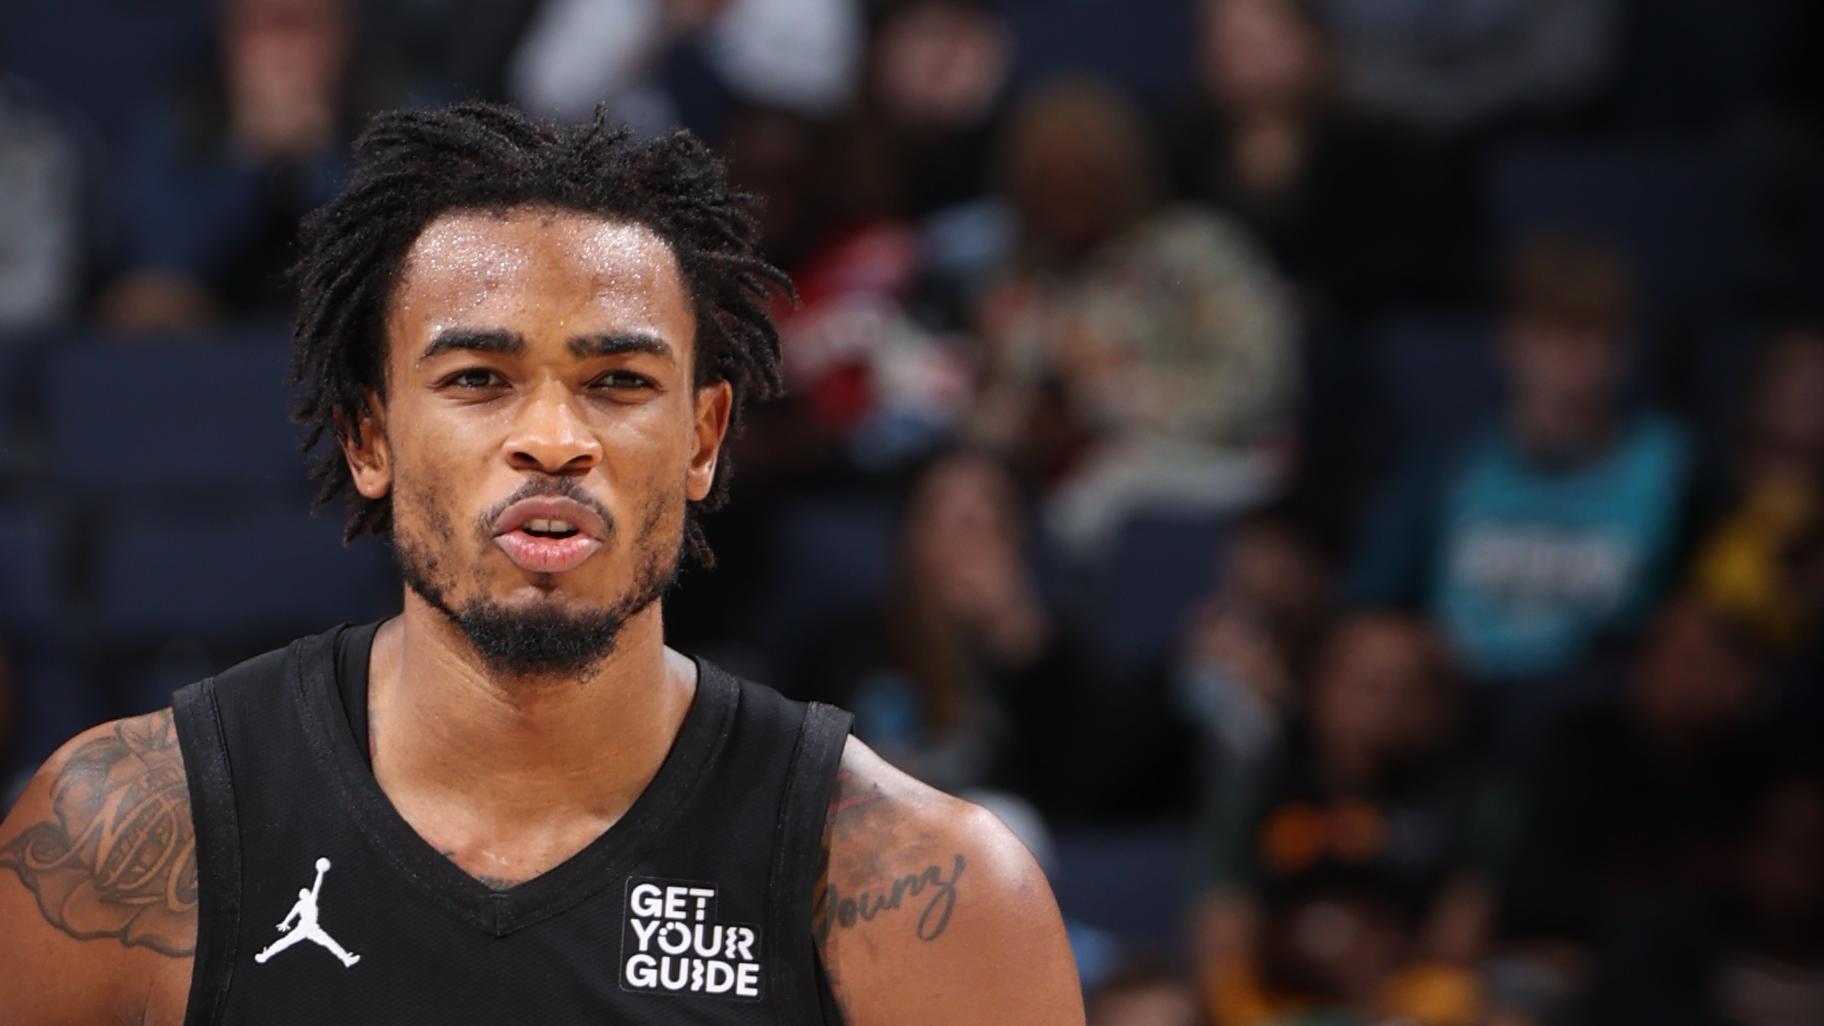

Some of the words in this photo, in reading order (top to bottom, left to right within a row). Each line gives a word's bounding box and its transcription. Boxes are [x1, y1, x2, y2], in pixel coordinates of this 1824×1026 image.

[630, 884, 715, 921] GET
[630, 918, 755, 960] YOUR
[625, 954, 760, 996] GUIDE
